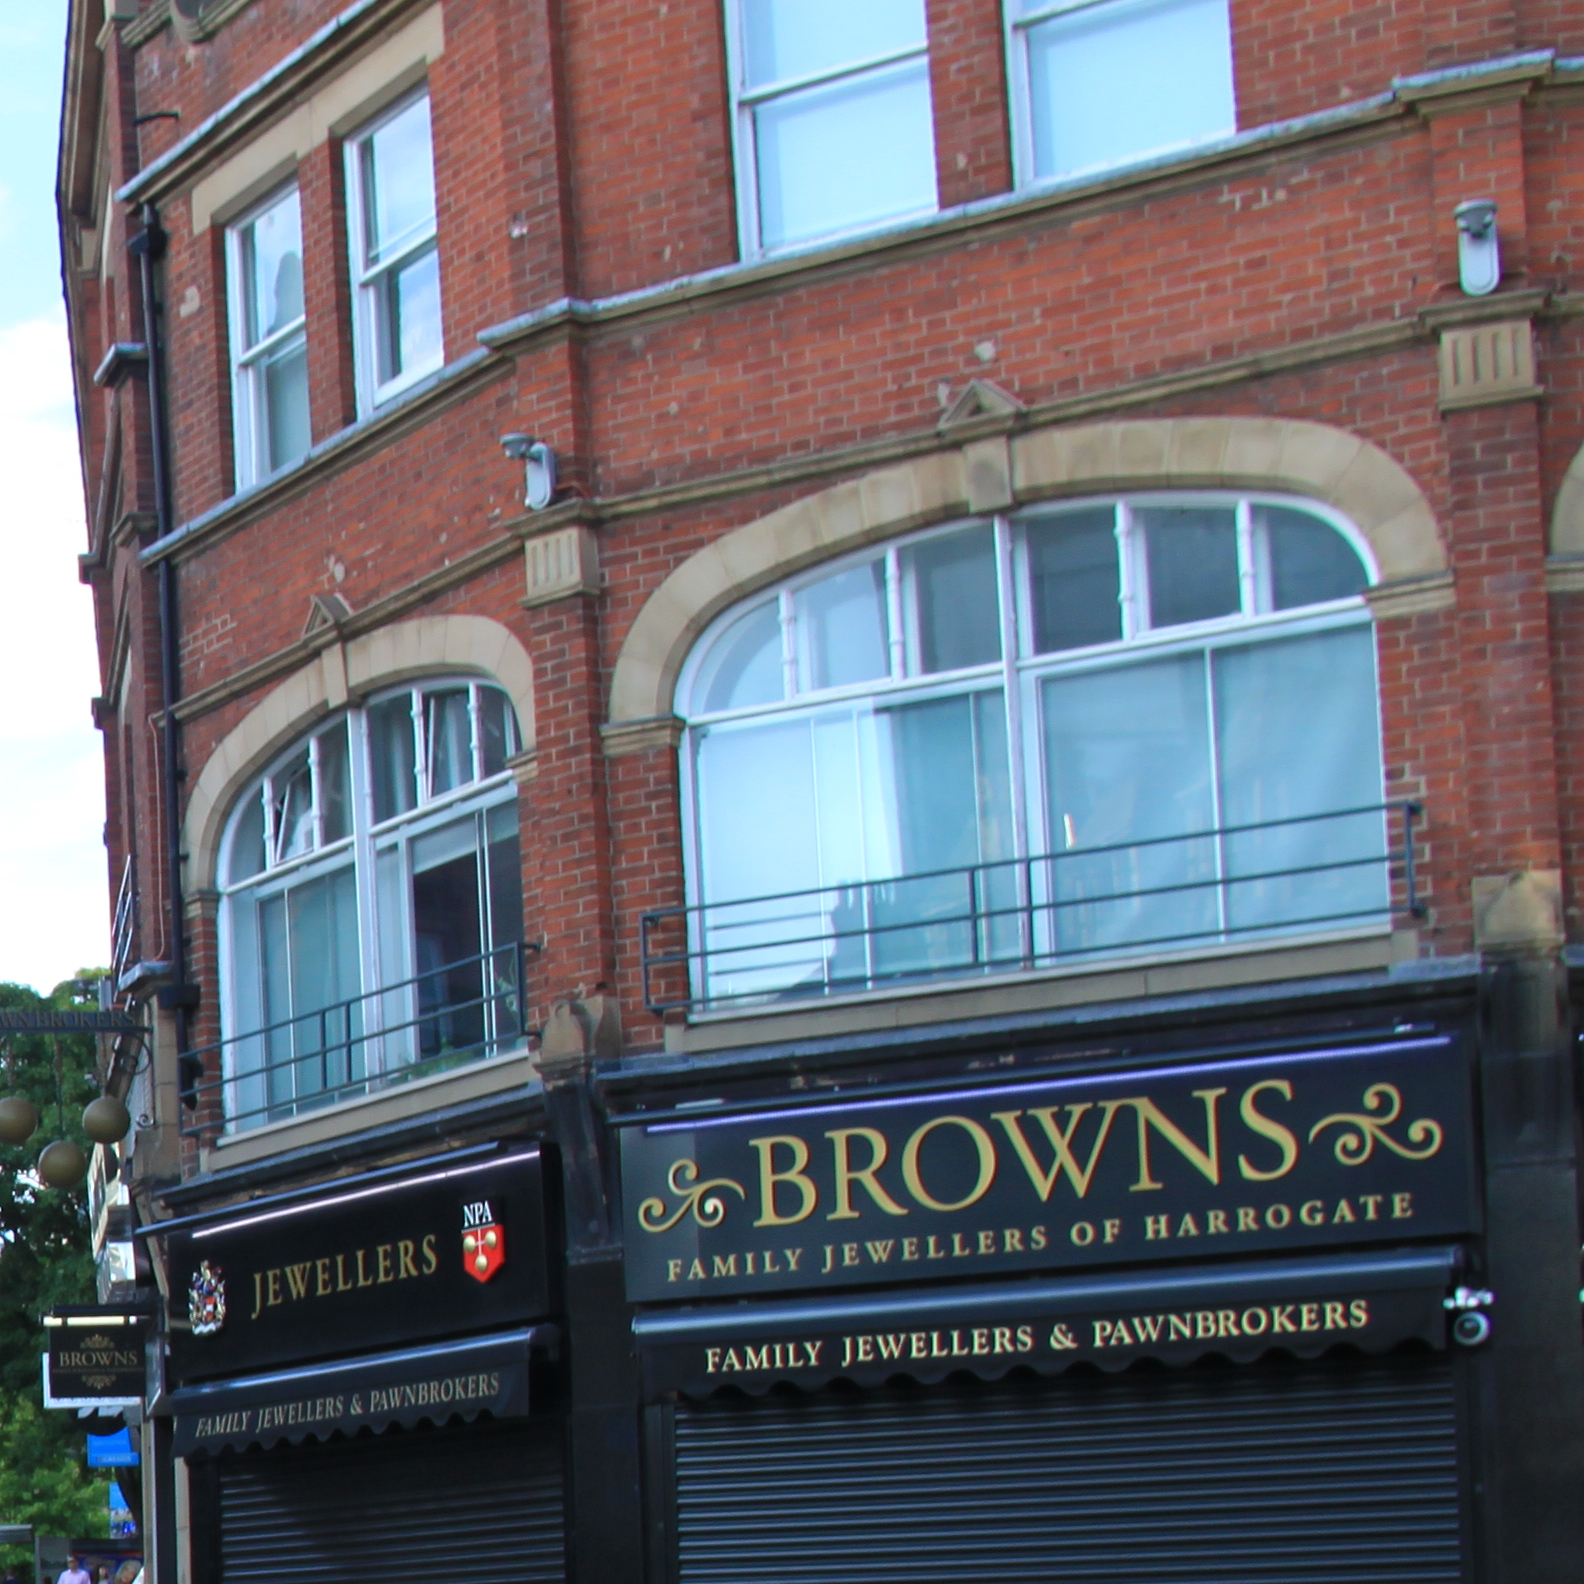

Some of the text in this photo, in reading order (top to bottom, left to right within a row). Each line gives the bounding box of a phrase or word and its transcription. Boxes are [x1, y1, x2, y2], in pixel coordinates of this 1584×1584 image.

[749, 1076, 1300, 1228] BROWNS
[462, 1200, 493, 1228] NPA
[666, 1192, 1415, 1283] FAMILY JEWELLERS OF HARROGATE
[251, 1233, 439, 1320] JEWELLERS
[58, 1350, 138, 1368] BROWNS
[704, 1299, 1370, 1373] FAMILY JEWELLERS & PAWNBROKERS
[195, 1372, 500, 1438] FAMILY JEWELLERS & PAWNBROKERS
